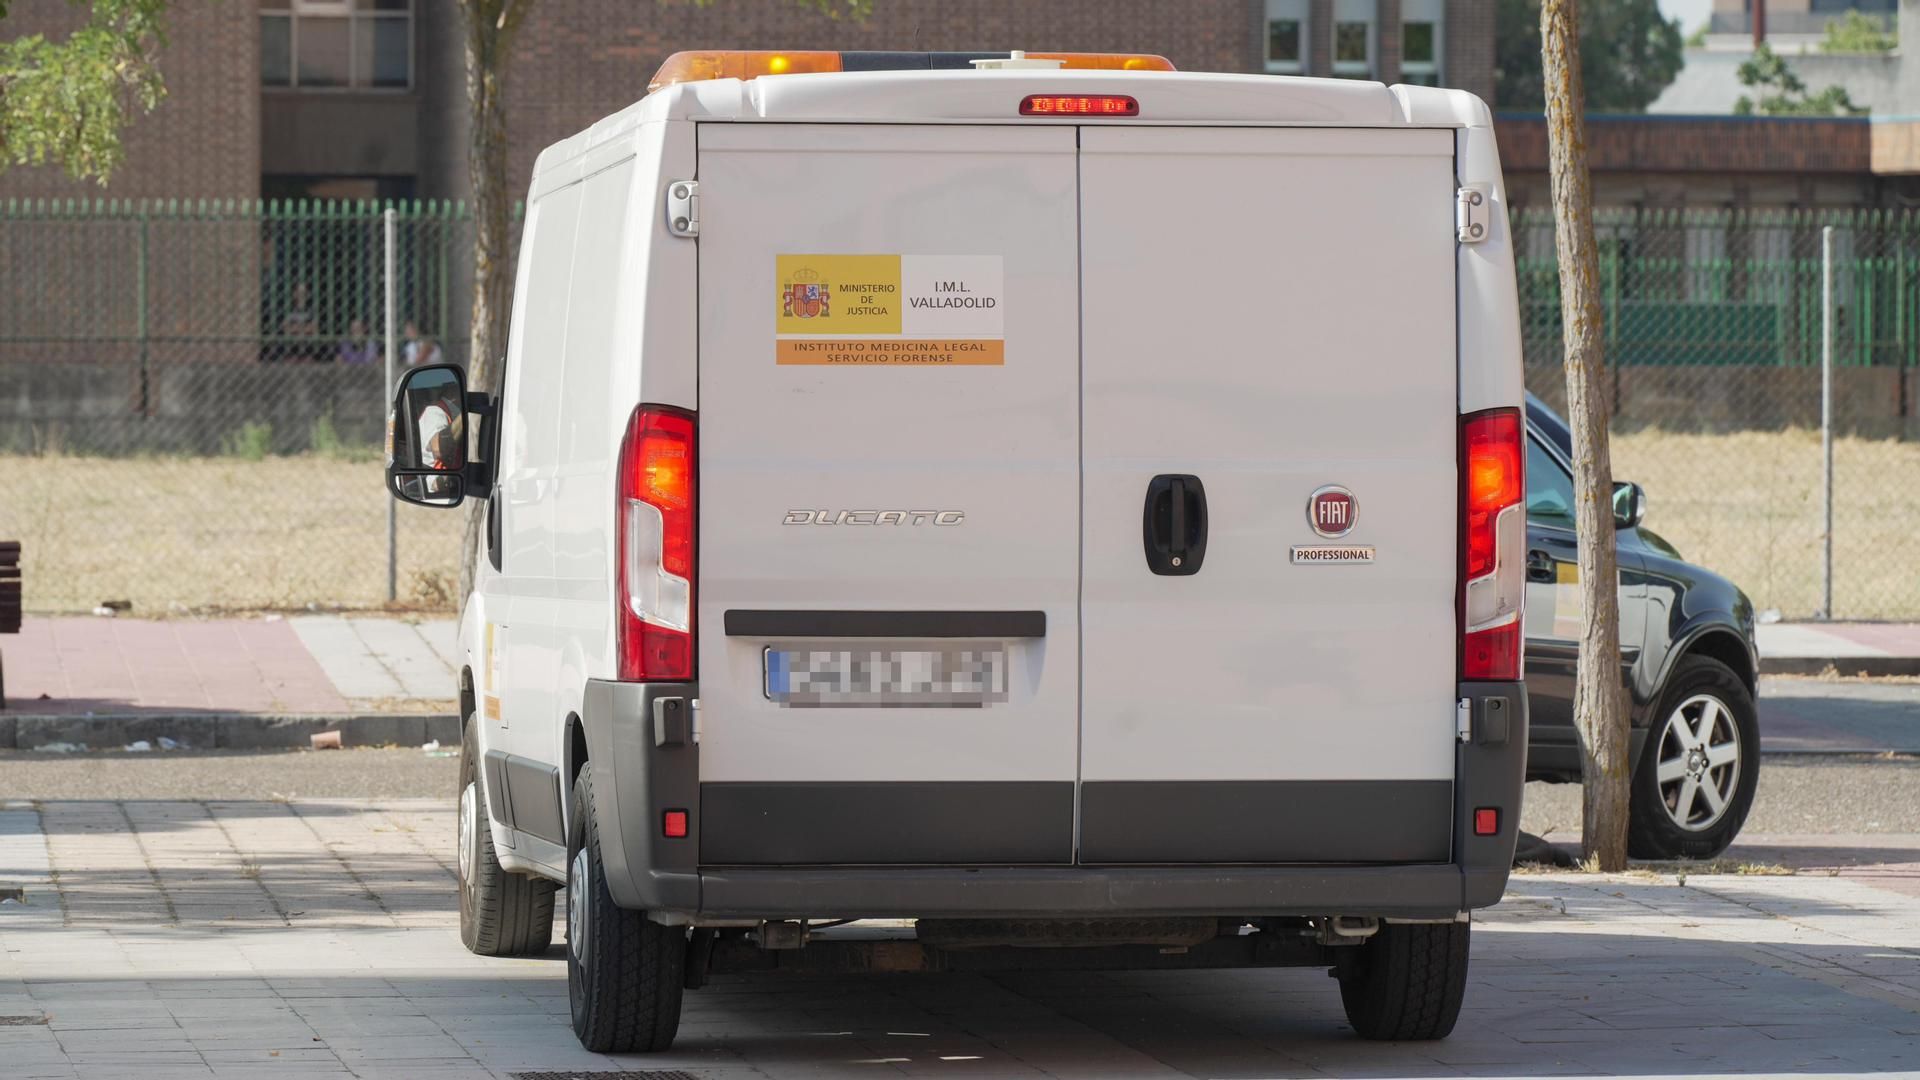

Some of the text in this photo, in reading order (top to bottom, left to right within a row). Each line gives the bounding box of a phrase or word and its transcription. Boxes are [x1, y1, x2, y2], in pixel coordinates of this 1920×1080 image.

[839, 284, 895, 293] MINISTERIO
[935, 281, 971, 292] I.M.L.
[861, 296, 873, 304] DE
[910, 297, 996, 308] VALLADOLID
[847, 307, 888, 315] JUSTICIA
[794, 343, 986, 351] INSTITUTO MEDICINA LEGAL
[827, 354, 953, 362] SERVICIO FORENSE
[1319, 501, 1348, 524] FIAT
[782, 509, 965, 526] DUCATO
[1297, 550, 1370, 560] PROFESSIONAL
